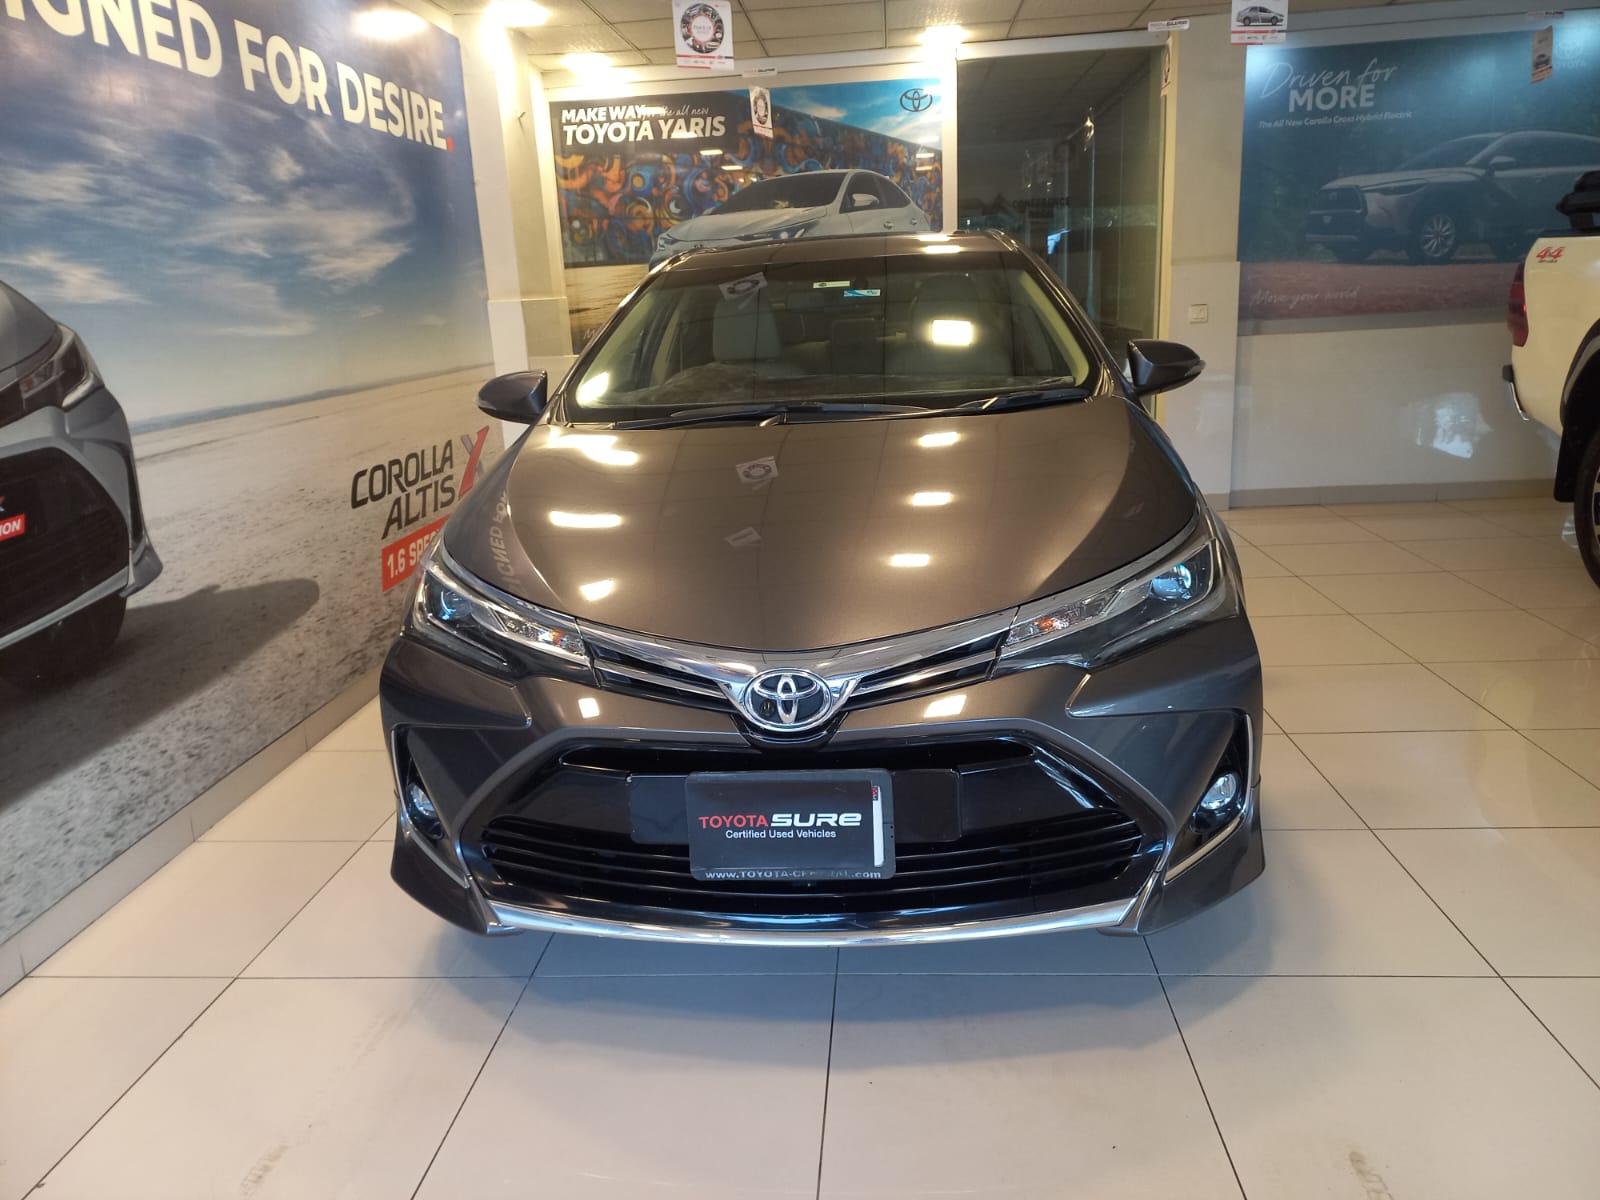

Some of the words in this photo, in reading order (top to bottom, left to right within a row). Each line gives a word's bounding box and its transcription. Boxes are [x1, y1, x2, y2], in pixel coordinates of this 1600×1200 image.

[233, 19, 332, 116] FOR
[336, 61, 454, 153] DESIRE.
[1260, 61, 1350, 99] Driven
[1356, 56, 1398, 91] for
[561, 106, 607, 124] MAKE
[676, 103, 690, 116] all
[1288, 83, 1376, 112] MORE
[563, 120, 654, 146] TOYOTA
[658, 115, 727, 140] YARIS
[351, 439, 454, 509] COROLLA
[381, 474, 456, 540] ALTIS
[387, 547, 406, 579] 1.6
[409, 528, 440, 567] SPE
[698, 815, 769, 829] TOYOTA
[725, 829, 767, 839] Certified
[768, 829, 794, 839] Used
[796, 828, 837, 839] Vehicles
